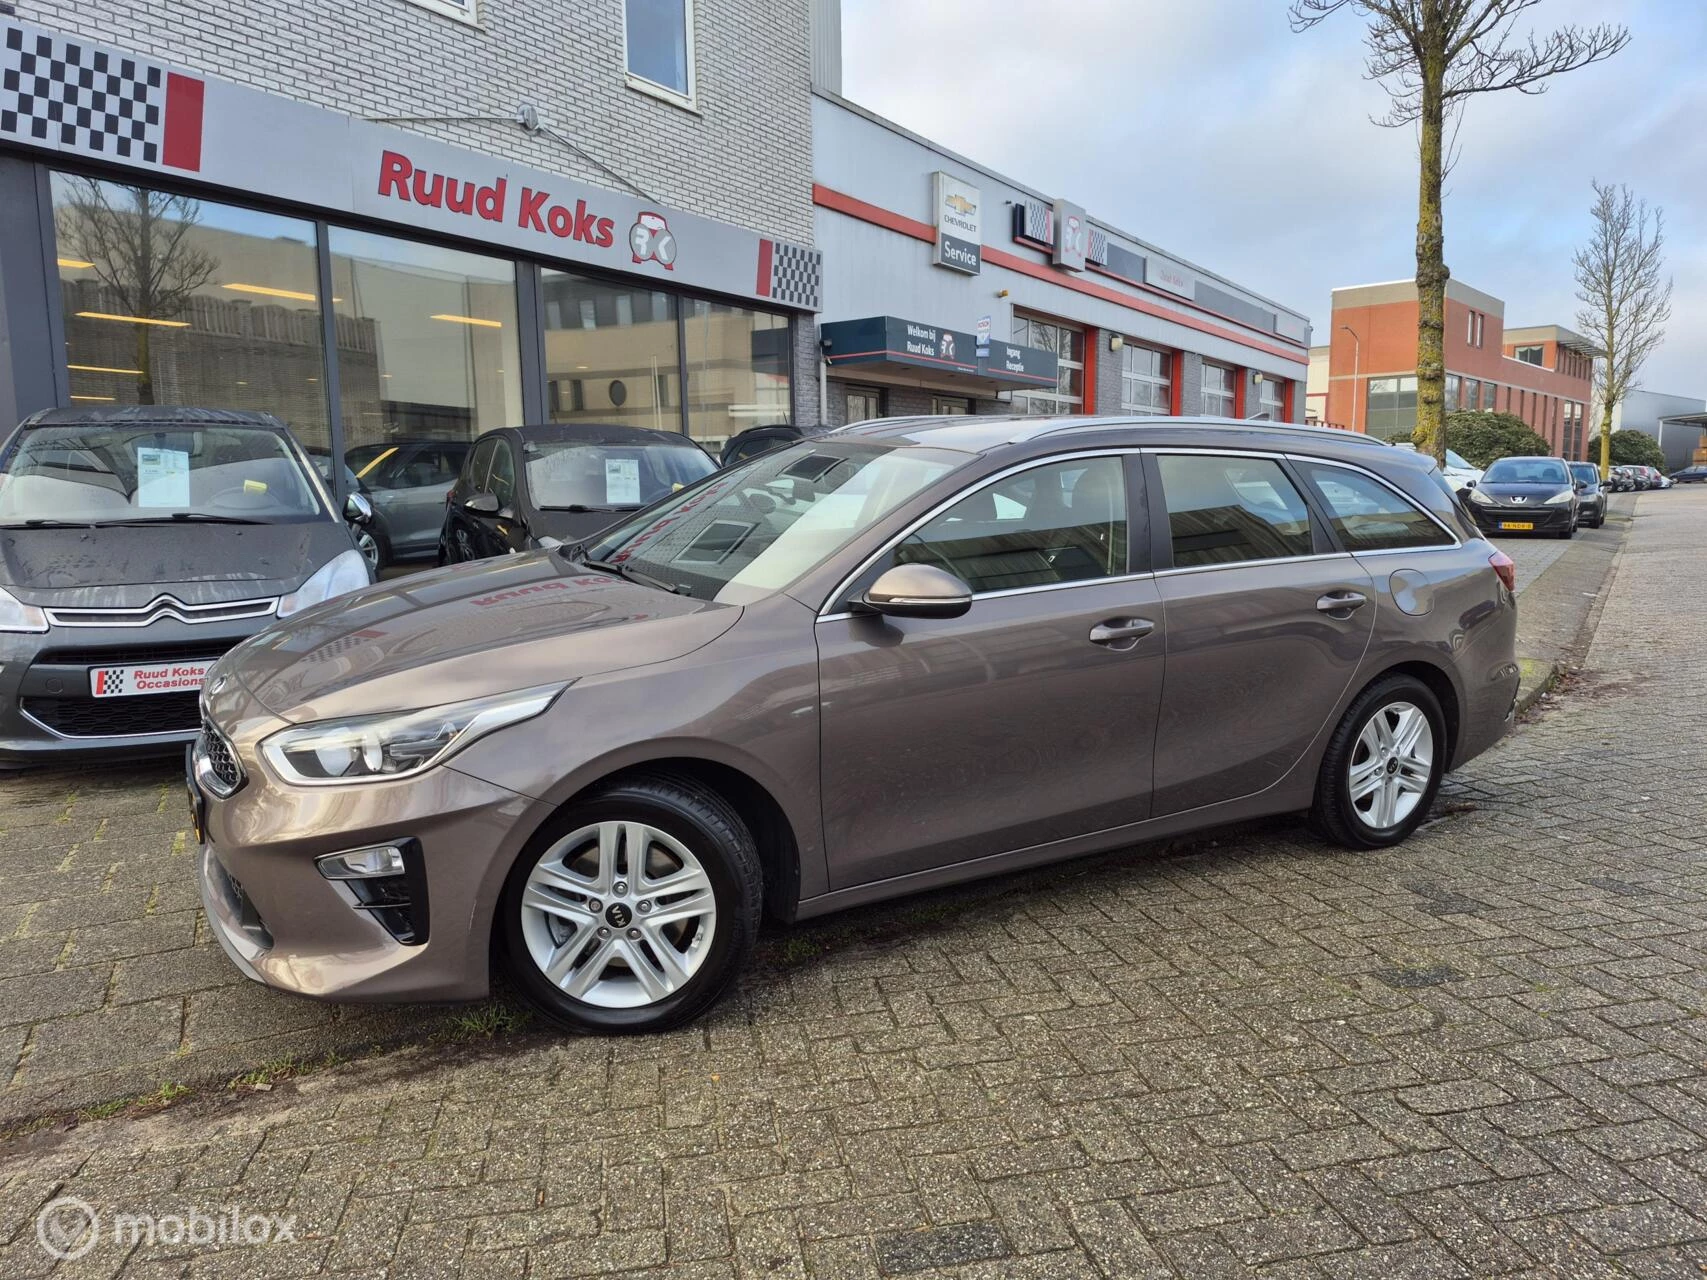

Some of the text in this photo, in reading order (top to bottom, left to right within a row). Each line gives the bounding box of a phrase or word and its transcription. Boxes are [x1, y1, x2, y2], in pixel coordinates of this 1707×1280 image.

[377, 149, 616, 249] Ruud Koks
[944, 214, 977, 232] CHEVROLET
[944, 240, 977, 266] Service
[907, 324, 928, 339] Welkom
[906, 341, 921, 354] Ruud
[134, 666, 205, 680] Ruud Koks
[136, 678, 206, 689] Occasions
